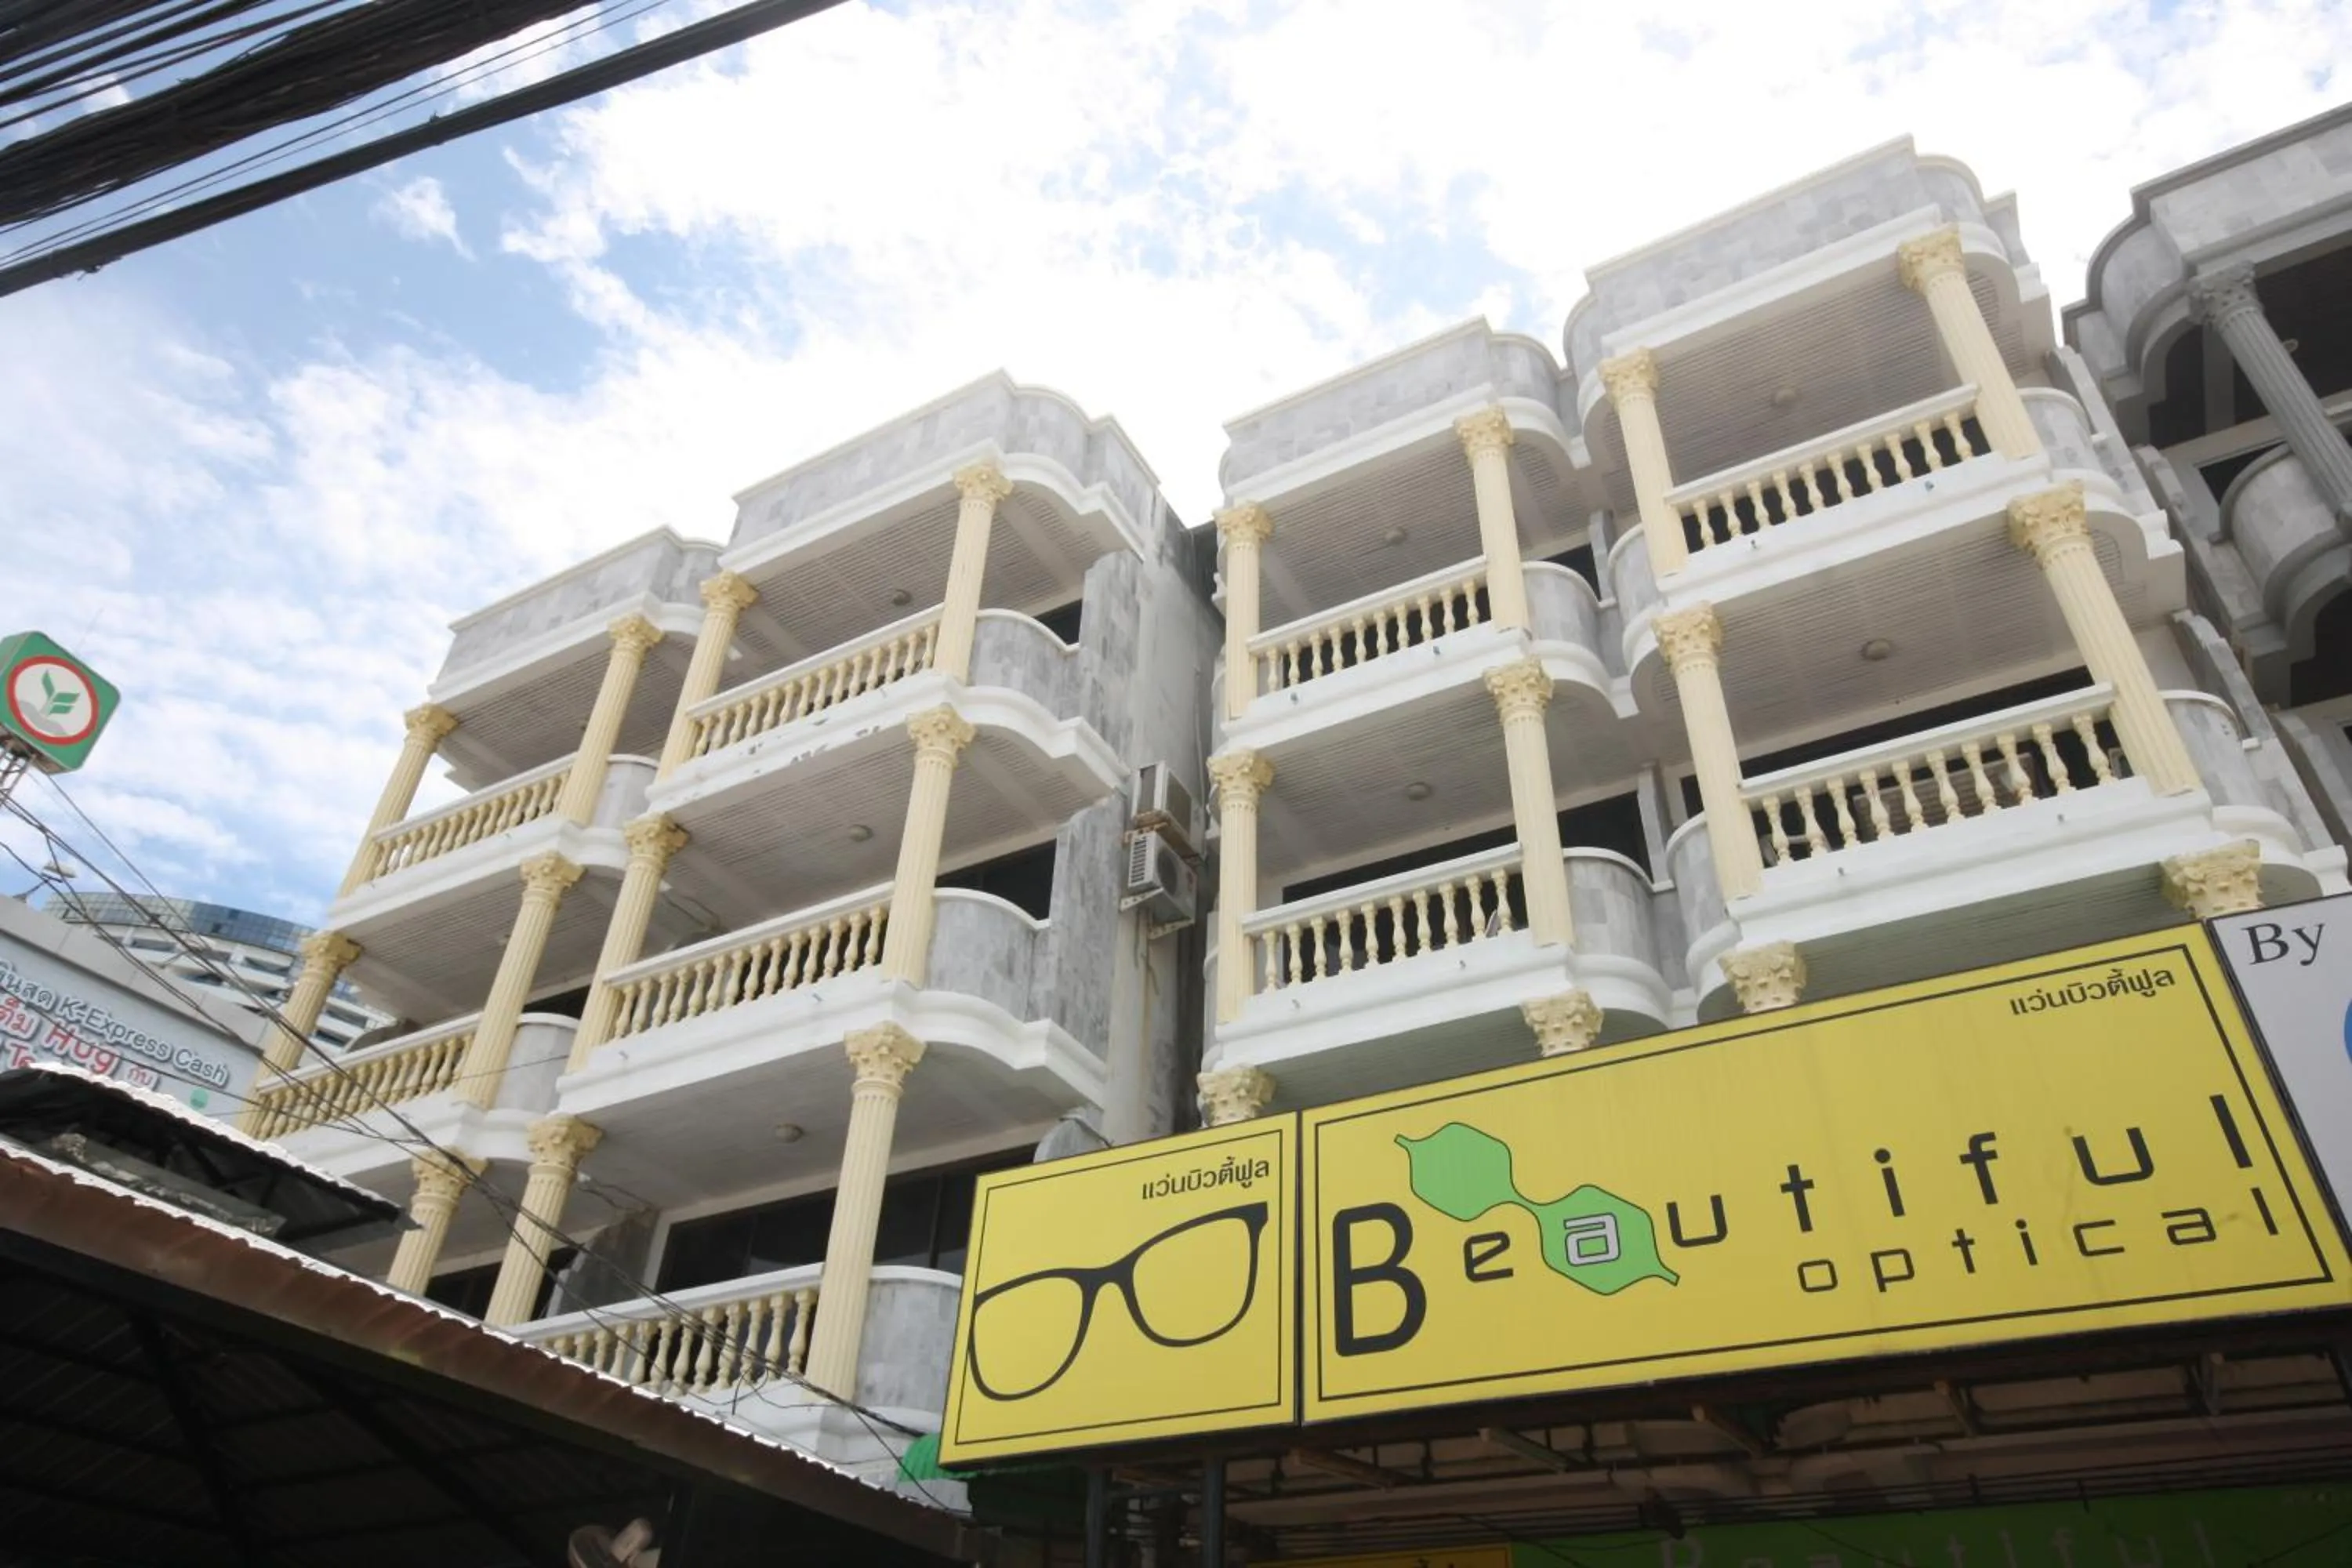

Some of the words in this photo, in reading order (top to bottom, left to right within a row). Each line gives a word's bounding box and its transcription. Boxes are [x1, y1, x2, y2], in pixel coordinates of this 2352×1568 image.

[2241, 921, 2325, 966] By
[2009, 968, 2176, 1015] แว่นบิวตี้ฟูล
[45, 1022, 117, 1074] Hug
[59, 996, 169, 1057] K-Express
[175, 1048, 225, 1083] Cash
[1142, 1156, 1269, 1200] แว่นบิวตี้ฟูล
[1331, 1094, 2252, 1357] Beautiful
[1797, 1187, 2279, 1293] optical
